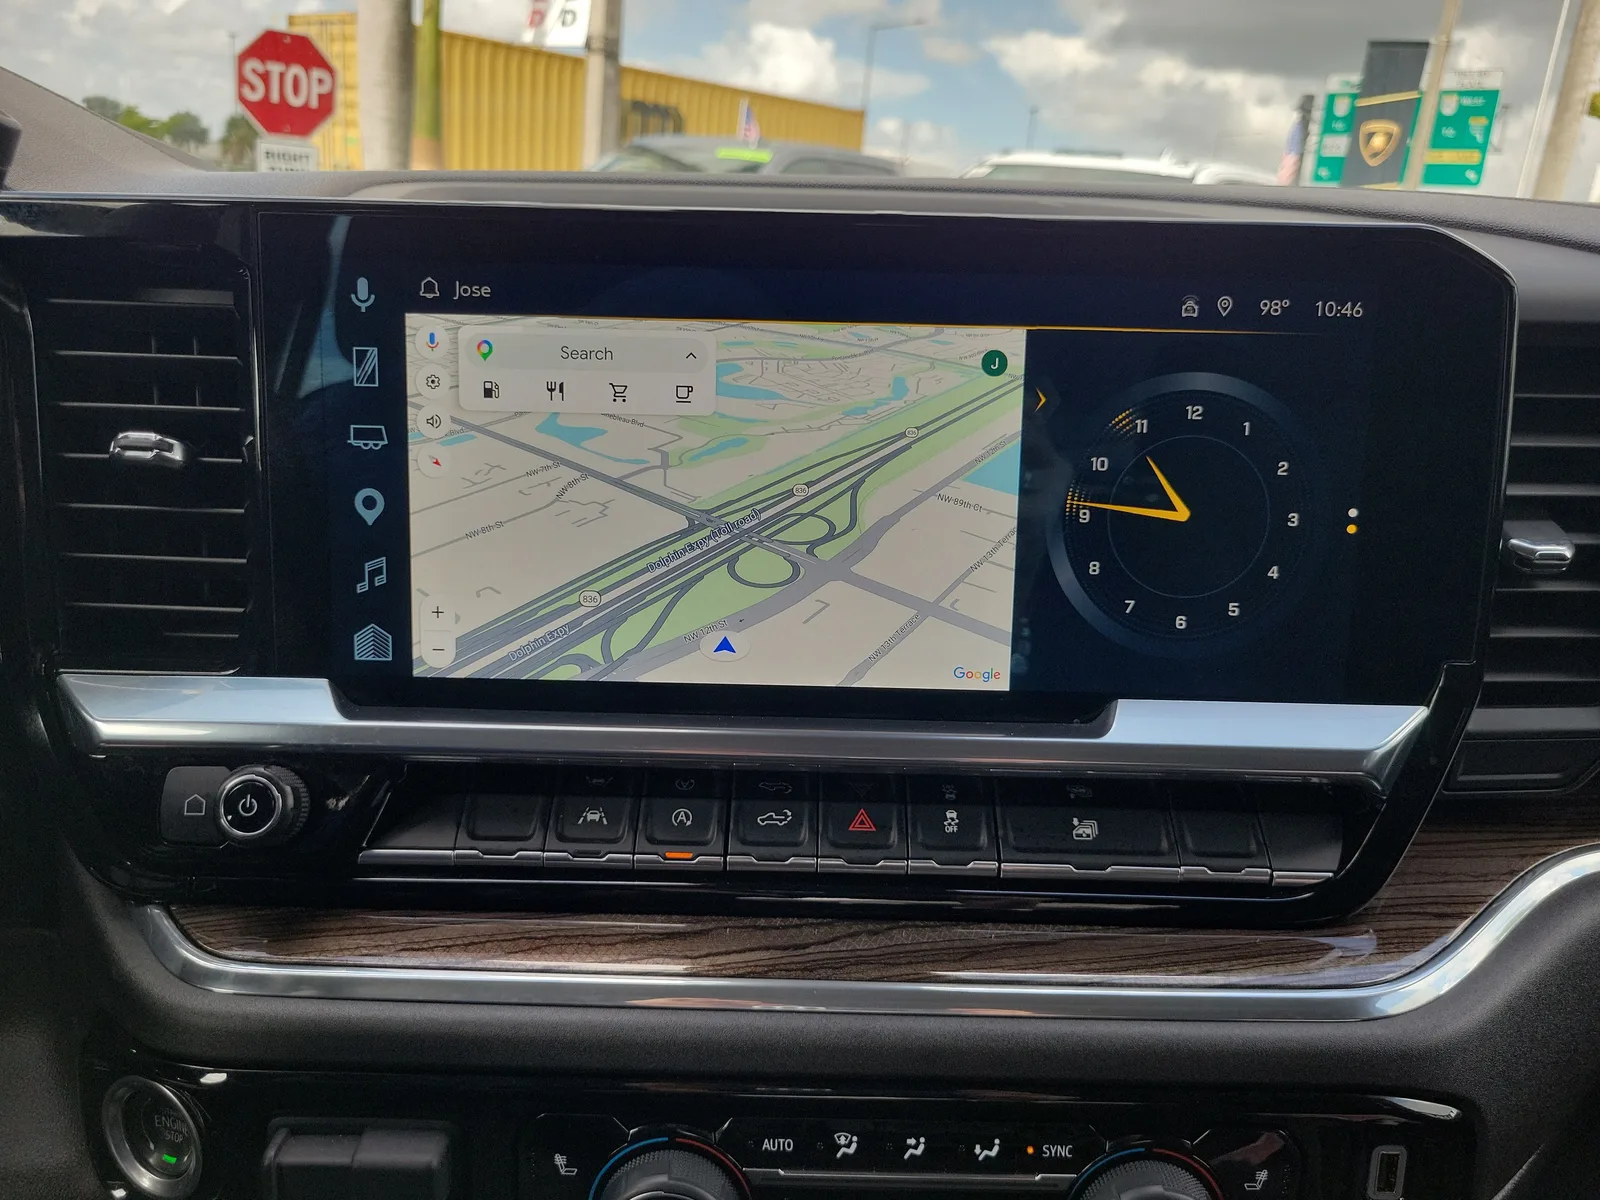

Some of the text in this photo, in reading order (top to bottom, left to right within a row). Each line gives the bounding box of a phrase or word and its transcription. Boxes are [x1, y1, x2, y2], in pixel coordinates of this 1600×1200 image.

[240, 58, 333, 109] STOP
[454, 281, 492, 300] Jose
[1259, 299, 1290, 316] 98°
[1315, 301, 1363, 318] 10:46
[560, 345, 614, 362] Search
[990, 357, 999, 370] J
[1186, 406, 1204, 420] 12
[630, 418, 645, 428] Blvd
[1135, 420, 1149, 434] 11
[1243, 422, 1251, 436] 1
[449, 427, 466, 437] Blvd
[974, 440, 1008, 465] NW 12th St
[525, 461, 561, 478] NW 7th St
[1091, 457, 1109, 471] 10
[1277, 462, 1289, 476] 2
[556, 472, 590, 500] NW 8th St
[794, 486, 808, 495] 836
[937, 493, 983, 513] NW 89th Ct
[1078, 509, 1091, 523] 9
[1287, 513, 1300, 527] 3
[465, 520, 505, 541] NW 8th St
[646, 508, 762, 573] Dolphin Expy (Toll road)
[970, 558, 984, 573] NW
[983, 545, 1000, 561] 13th
[1088, 561, 1101, 575] 8
[1267, 565, 1280, 579] 4
[582, 594, 599, 605] 836
[1124, 600, 1136, 613] 7
[1228, 603, 1240, 617] 5
[1175, 616, 1188, 629] 6
[683, 619, 729, 643] NW 12th St
[868, 613, 921, 663] NW 13th Terrace
[508, 624, 571, 662] Dolphin Expy
[953, 666, 1001, 683] Google
[944, 825, 959, 834] OFF
[154, 1114, 189, 1137] ENGINE
[163, 1129, 185, 1144] STOP
[762, 1137, 794, 1152] AUTO
[1042, 1144, 1074, 1159] SYNC
